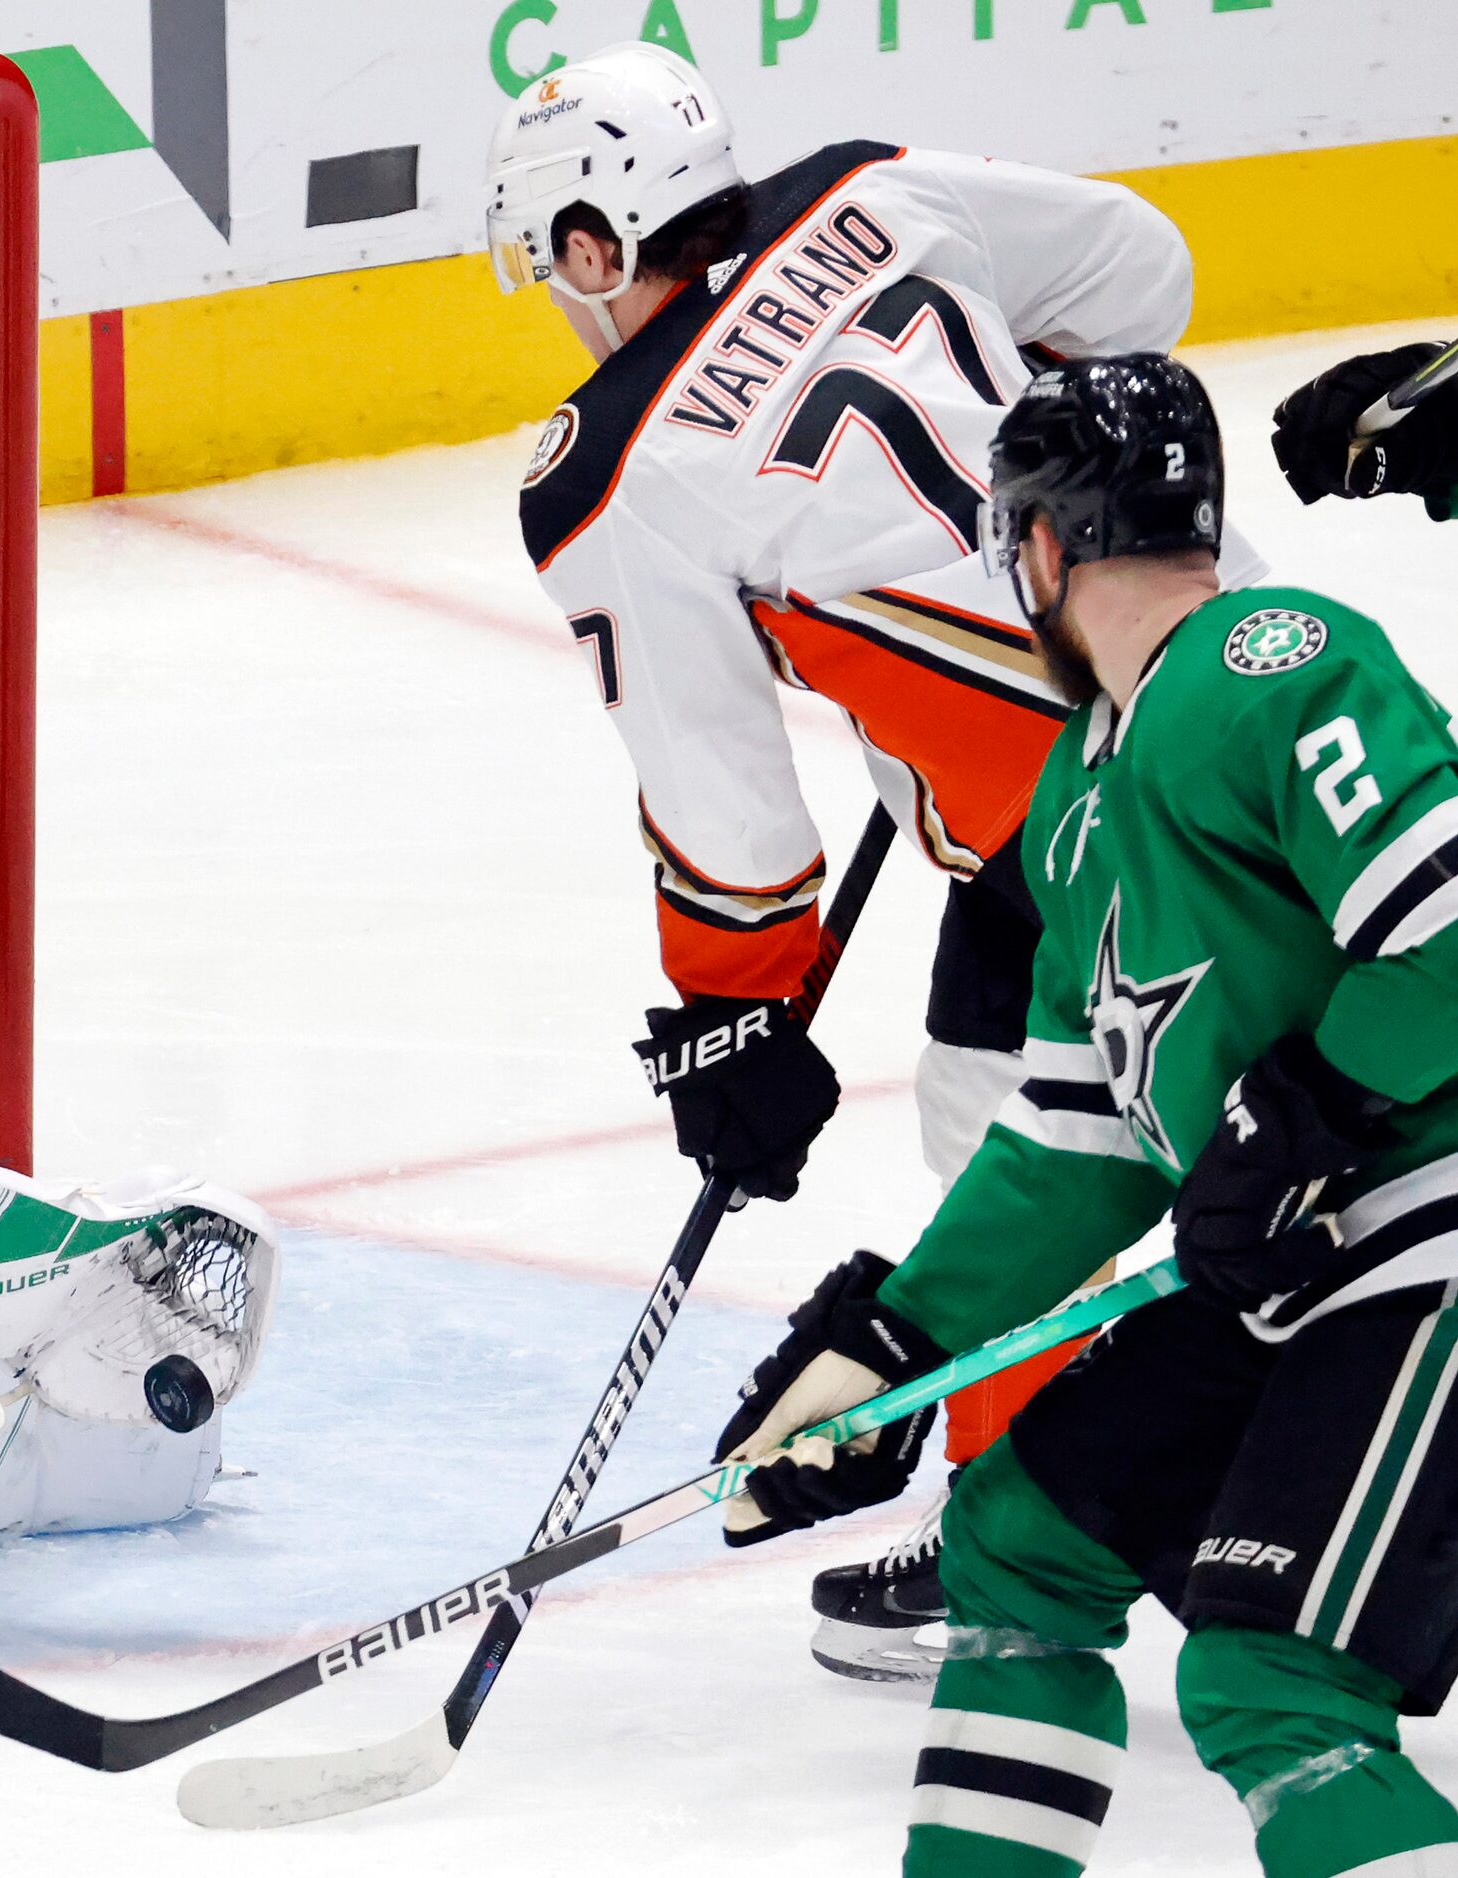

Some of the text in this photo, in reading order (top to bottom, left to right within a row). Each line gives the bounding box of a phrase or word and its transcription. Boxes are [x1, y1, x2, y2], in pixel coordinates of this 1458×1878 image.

[517, 98, 583, 130] Navigator
[664, 200, 899, 439] VATRANO
[757, 273, 1008, 557] 77
[1164, 443, 1186, 481] 2
[1295, 715, 1382, 837] 2
[641, 1006, 773, 1086] AUER
[1191, 1536, 1298, 1575] AUER
[317, 1567, 513, 1686] BAUER
